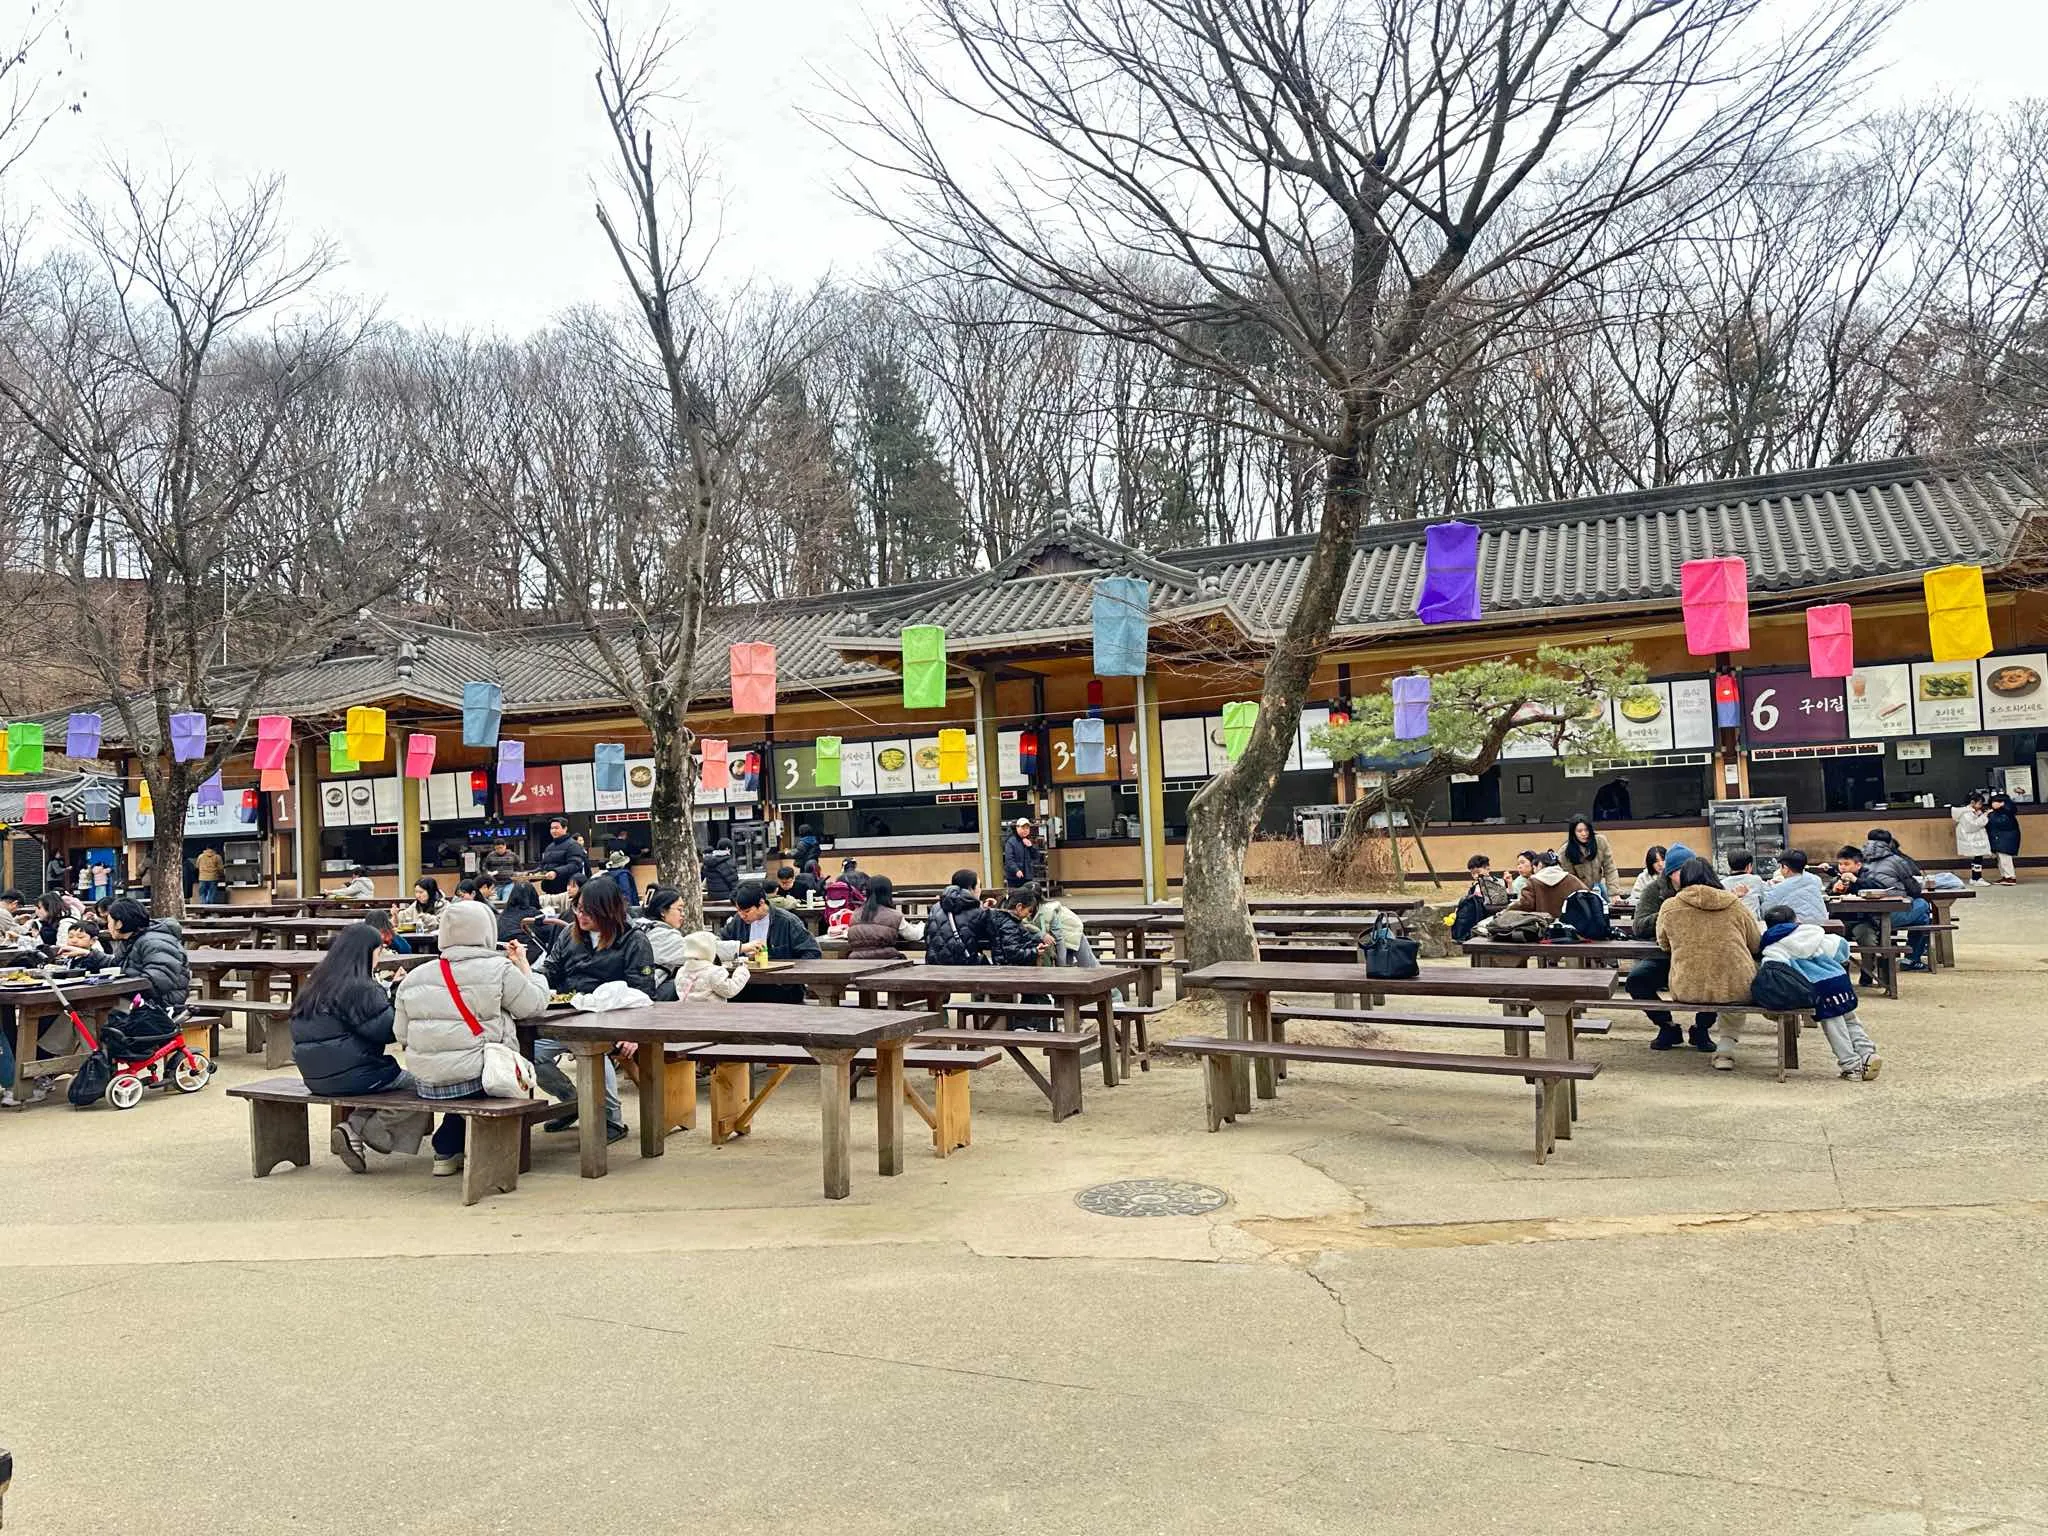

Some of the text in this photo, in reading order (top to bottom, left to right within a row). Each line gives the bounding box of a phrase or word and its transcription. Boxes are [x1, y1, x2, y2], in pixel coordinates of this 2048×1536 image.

[1751, 688, 1779, 732] 6
[1799, 695, 1845, 714] 구이집
[783, 758, 800, 790] 3
[510, 783, 528, 803] 2
[276, 795, 289, 821] 1
